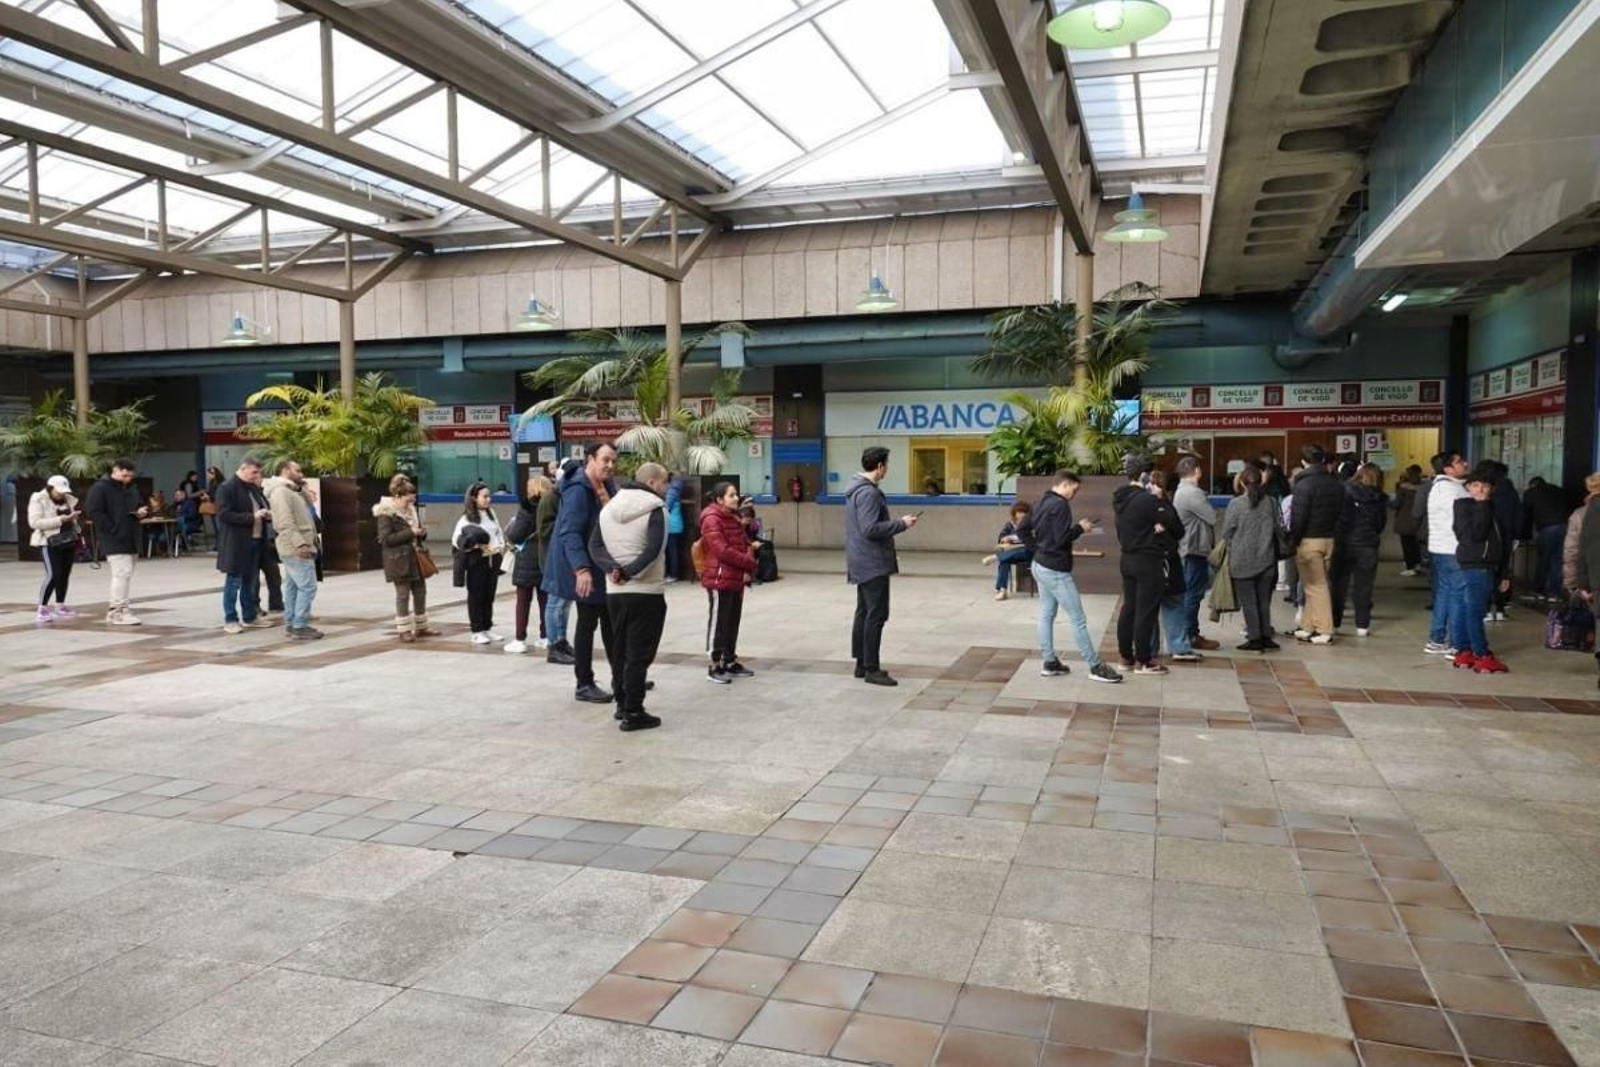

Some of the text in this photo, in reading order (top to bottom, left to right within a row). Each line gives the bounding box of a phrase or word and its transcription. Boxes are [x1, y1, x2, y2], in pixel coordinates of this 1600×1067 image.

[1218, 389, 1259, 397] CONCELLO
[1293, 387, 1336, 395] CONCELLO
[1369, 385, 1414, 394] CONCELLO
[1236, 396, 1254, 404] VIGO
[1312, 394, 1330, 402] VIGO
[1374, 392, 1409, 401] DE VIGO
[1368, 435, 1378, 449] 9
[575, 447, 581, 457] 4
[751, 445, 758, 455] 5
